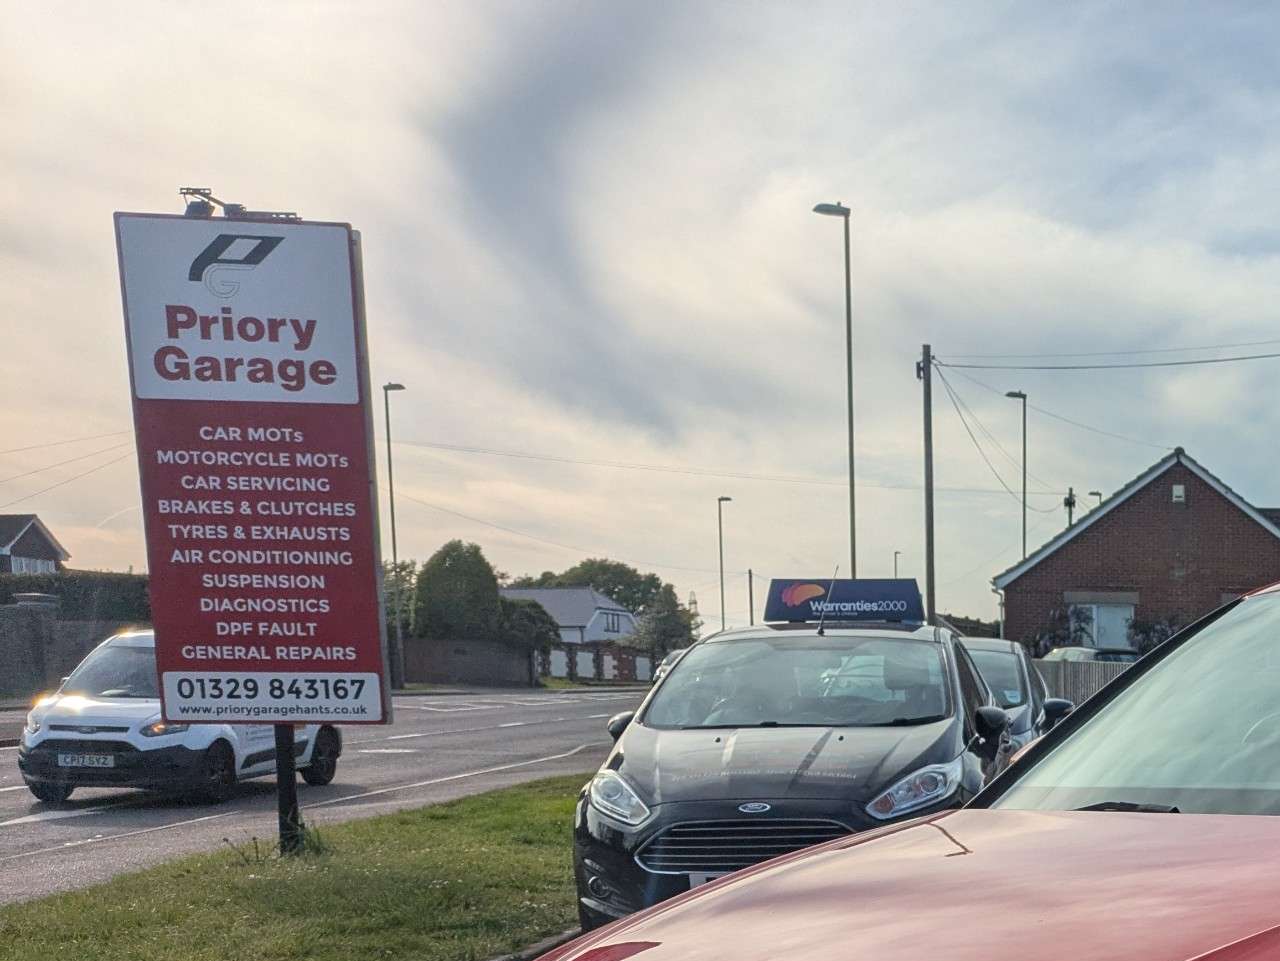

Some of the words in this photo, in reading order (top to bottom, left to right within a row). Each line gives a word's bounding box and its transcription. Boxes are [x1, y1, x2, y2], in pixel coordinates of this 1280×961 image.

[165, 304, 317, 351] Priory
[153, 345, 337, 392] Garage
[199, 426, 241, 441] CAR
[248, 427, 305, 443] MOTs
[156, 450, 290, 467] MOTORCYCLE
[296, 453, 349, 468] MOTs
[181, 475, 221, 490] CAR
[226, 476, 330, 492] SERVICING
[158, 500, 234, 515] BRAKES
[239, 501, 251, 515] &
[256, 501, 356, 517] CLUTCHES
[168, 524, 228, 539] TYRES
[233, 526, 246, 539] &
[251, 526, 350, 541] EXHAUSTS
[170, 549, 203, 563] AIR
[208, 550, 353, 565] CONDITIONING
[202, 574, 325, 589] SUSPENSION
[200, 598, 330, 613] DIAGNOSTICS
[809, 600, 908, 612] Warranties2000
[216, 622, 252, 636] DPF
[258, 622, 317, 637] FAULT
[181, 645, 271, 660] GENERAL
[275, 646, 356, 661] REPAIRS
[177, 678, 259, 699] 01329
[269, 678, 365, 700] 843167
[179, 704, 368, 716] www.priorygaragehants.co.uk
